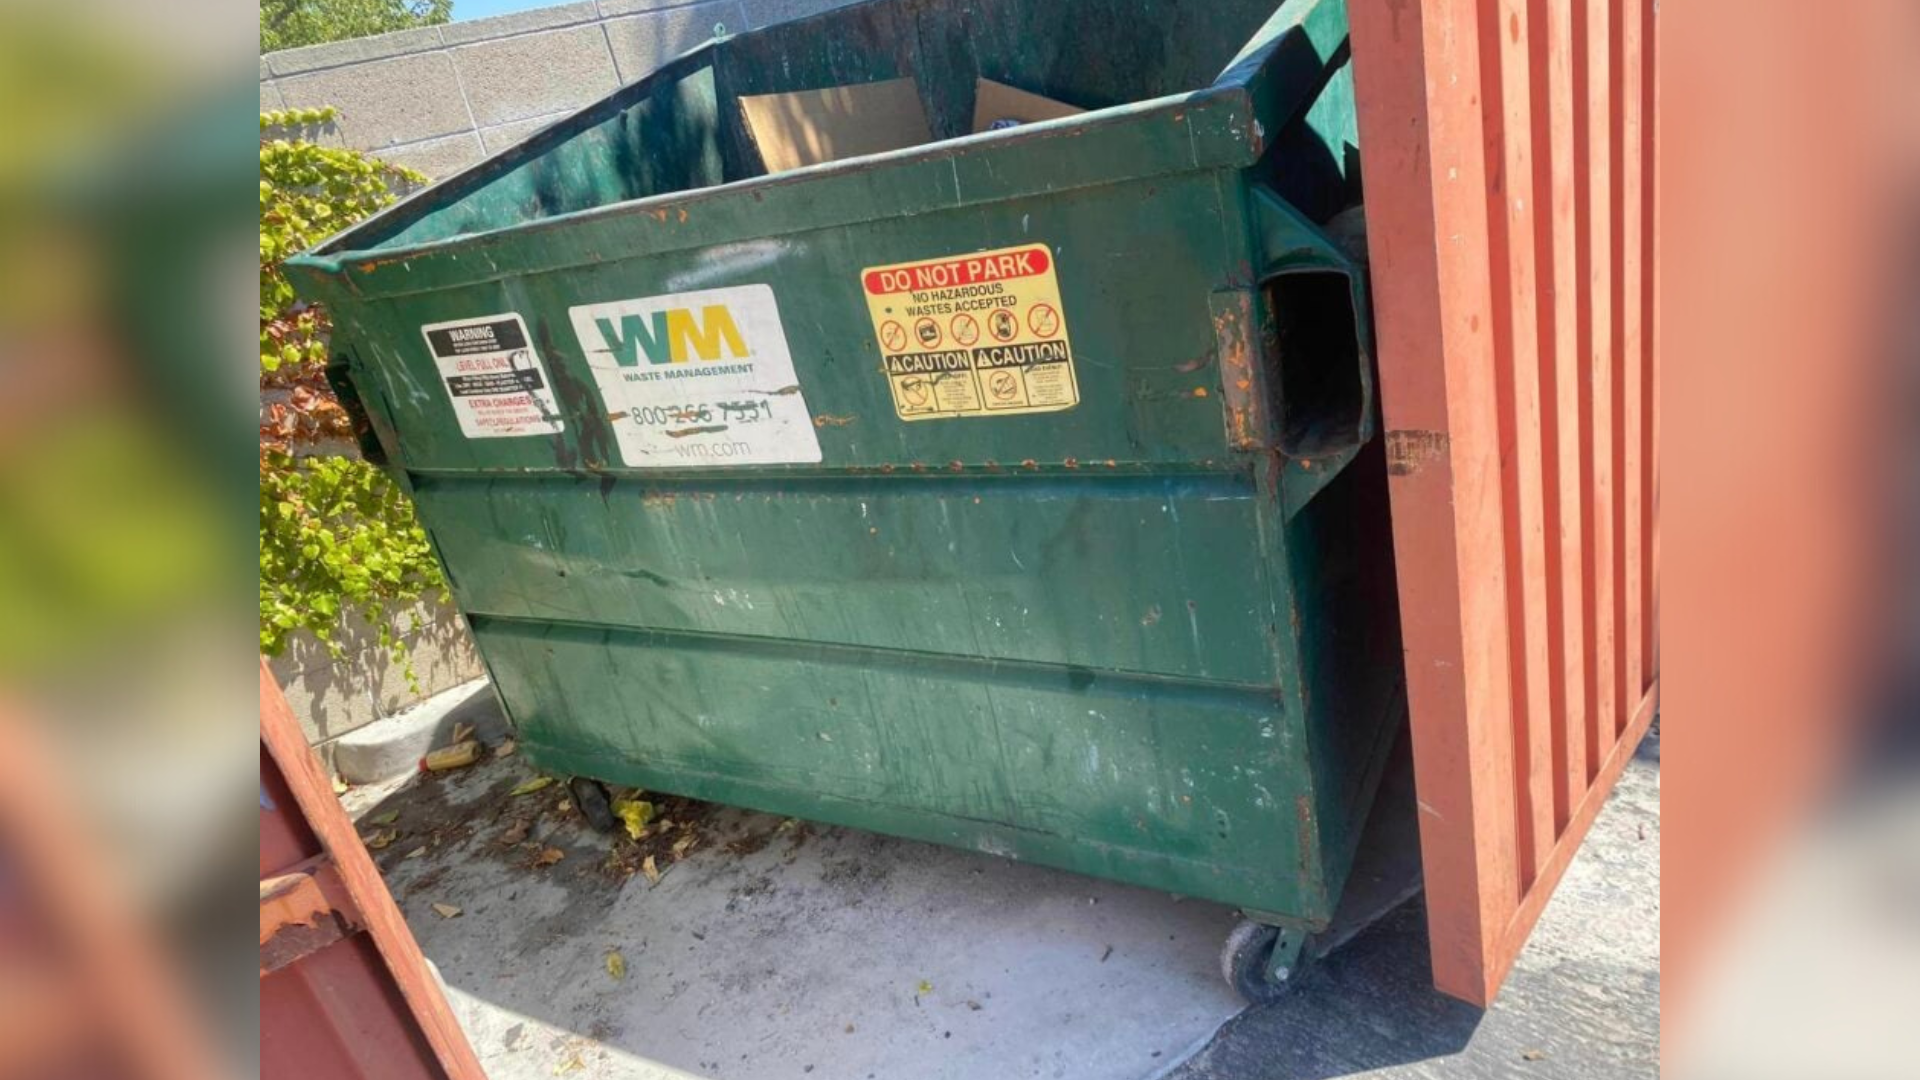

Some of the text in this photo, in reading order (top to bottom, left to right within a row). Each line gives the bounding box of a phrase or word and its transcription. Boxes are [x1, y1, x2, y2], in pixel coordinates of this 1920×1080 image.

[880, 253, 1034, 292] DO NOT PARK
[912, 283, 1004, 304] NO HAZARDOUS
[906, 295, 1017, 317] WASTES ACCEPTED
[449, 325, 494, 341] WARNING
[595, 304, 749, 367] WM
[903, 352, 969, 372] CAUTION
[990, 342, 1065, 365] CAUTION
[623, 363, 754, 382] WASTE MANAGEMENT
[493, 395, 532, 407] CHARGES
[675, 440, 751, 458] wm.com
